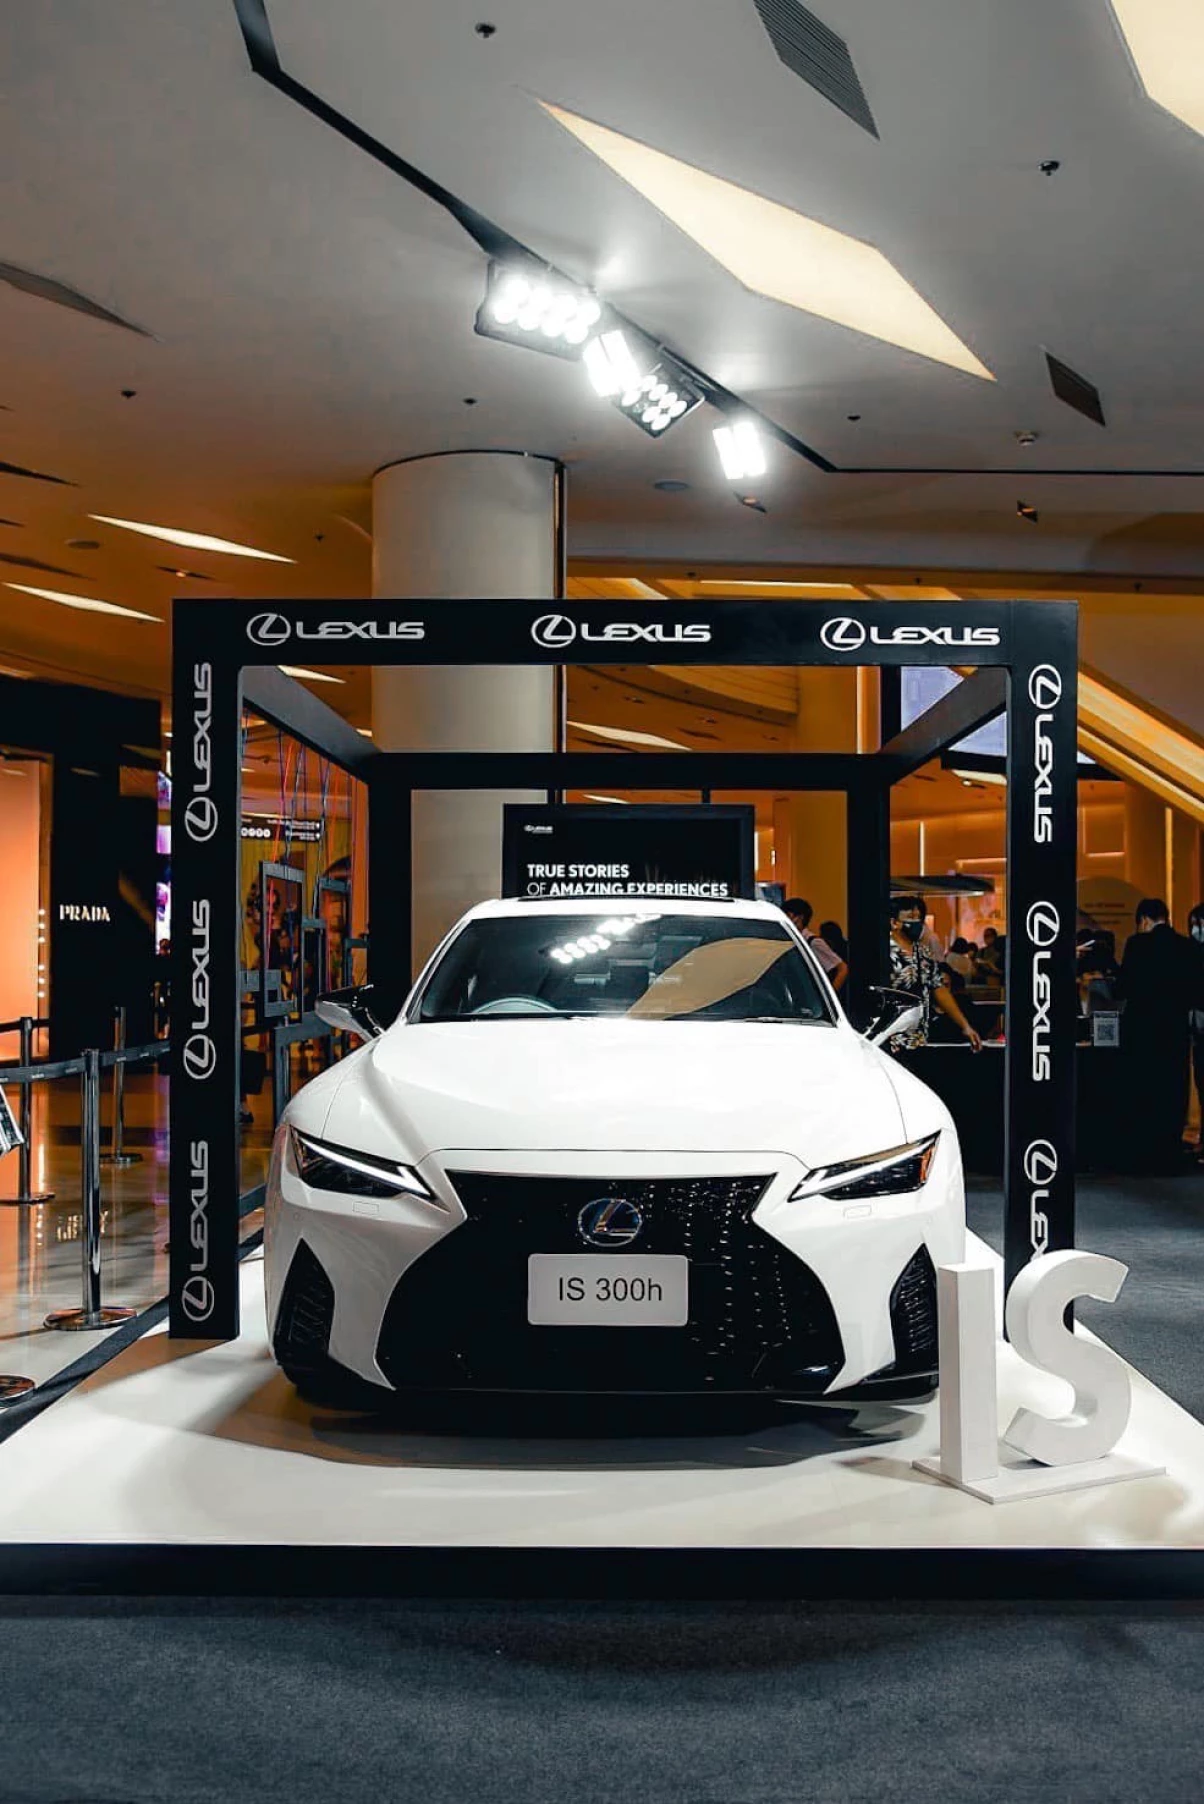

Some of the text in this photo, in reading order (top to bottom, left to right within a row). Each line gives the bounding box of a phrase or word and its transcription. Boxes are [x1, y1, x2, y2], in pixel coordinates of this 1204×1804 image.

[296, 622, 425, 639] LEXUS
[580, 624, 712, 642] LEXUS
[870, 627, 1000, 645] LEXUS
[193, 662, 212, 792] LEXUS
[1033, 713, 1053, 843] LEXUS
[527, 864, 630, 878] TRUE STORIES
[527, 882, 728, 896] OF AMAZING EXPERIENCES
[59, 904, 111, 921] PRADA
[191, 899, 210, 1030] LEXUS
[1032, 951, 1052, 1082] LEXUS
[191, 1140, 208, 1271] LEXUS
[1031, 1190, 1049, 1261] LEX
[559, 1277, 662, 1301] IS 300h
[938, 1248, 1131, 1484] IS
